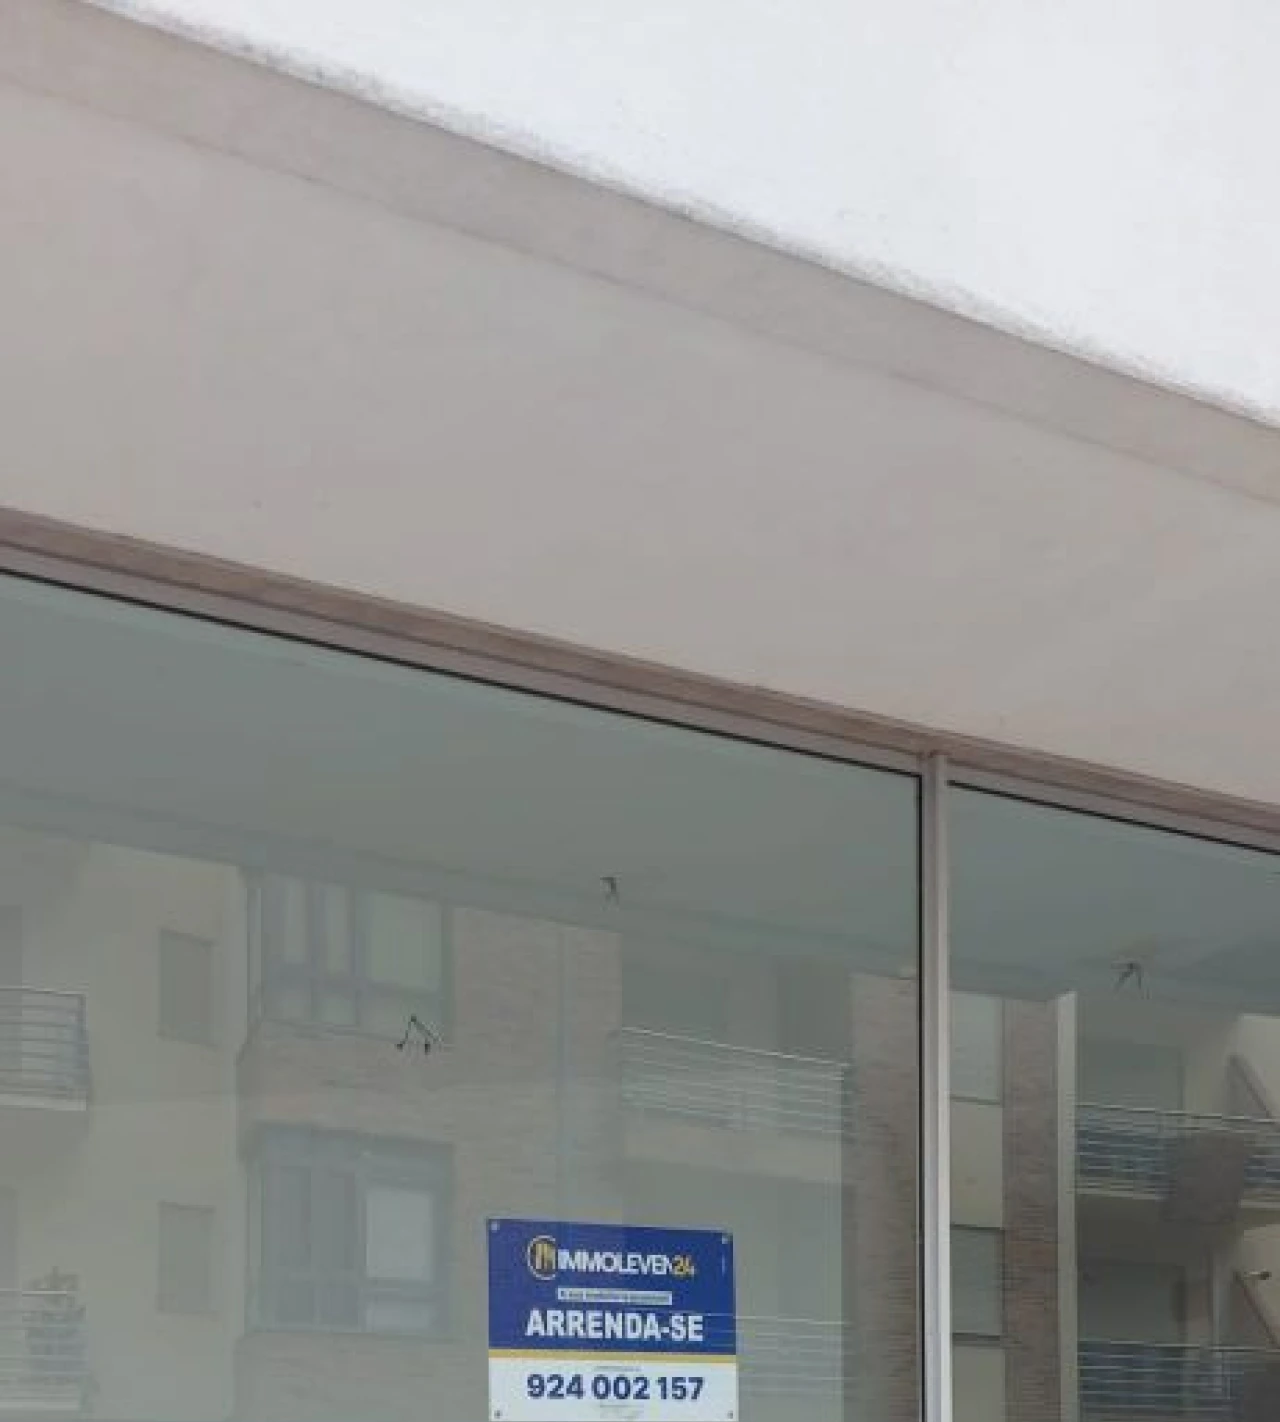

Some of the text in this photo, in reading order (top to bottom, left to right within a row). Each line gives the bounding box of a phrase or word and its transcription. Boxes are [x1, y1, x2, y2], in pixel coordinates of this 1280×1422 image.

[525, 1308, 704, 1341] ARRENDA-SE
[527, 1373, 704, 1400] 924 002 157
